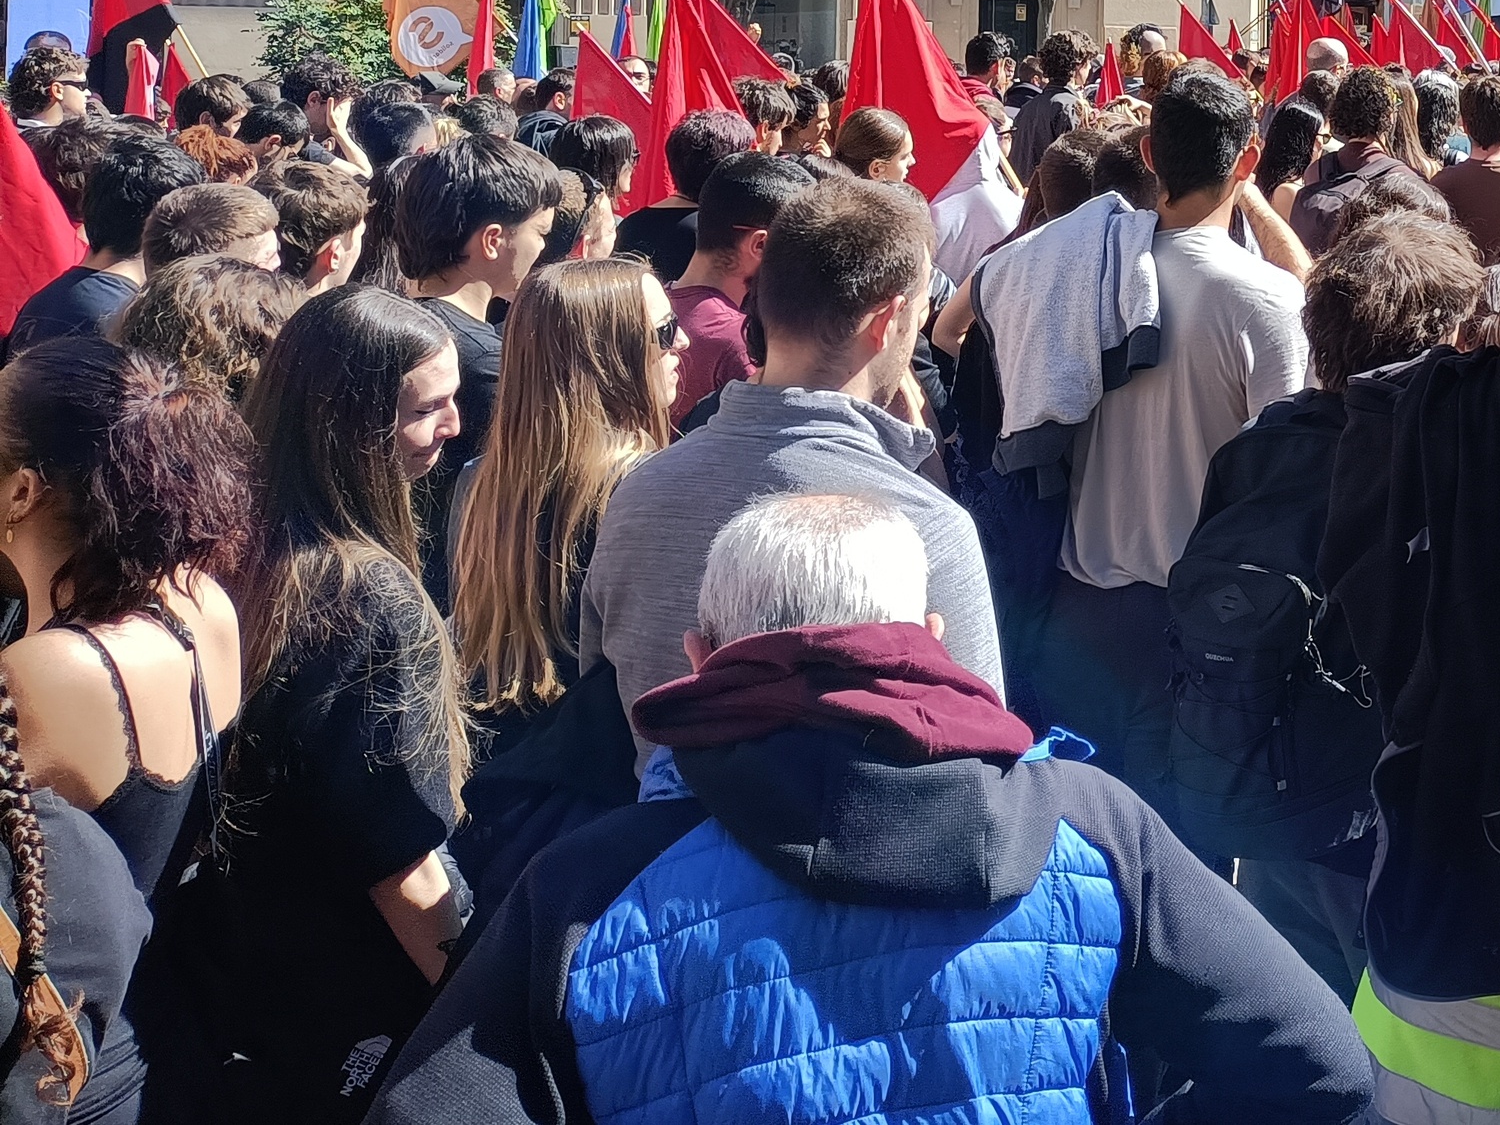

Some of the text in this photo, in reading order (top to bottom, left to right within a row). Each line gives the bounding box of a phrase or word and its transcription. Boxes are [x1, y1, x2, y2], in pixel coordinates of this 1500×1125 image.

[340, 1052, 370, 1097] NORTH
[341, 1047, 361, 1071] THE
[357, 1056, 380, 1088] FACE
